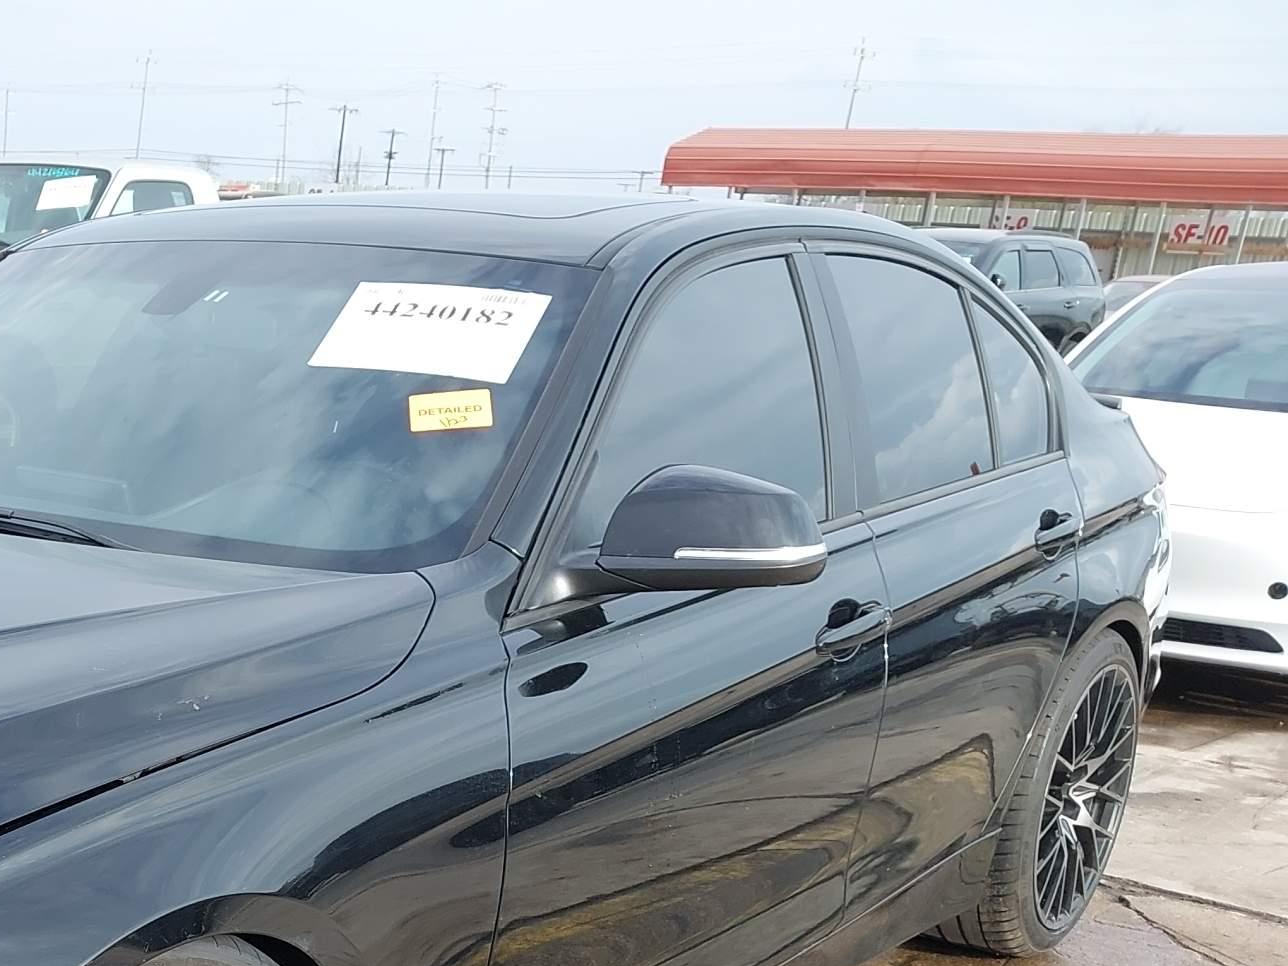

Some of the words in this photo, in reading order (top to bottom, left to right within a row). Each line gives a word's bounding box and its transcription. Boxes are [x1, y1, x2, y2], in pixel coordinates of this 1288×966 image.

[1170, 223, 1229, 245] SF-10
[364, 302, 514, 326] 44240182
[418, 404, 483, 416] DETAILED
